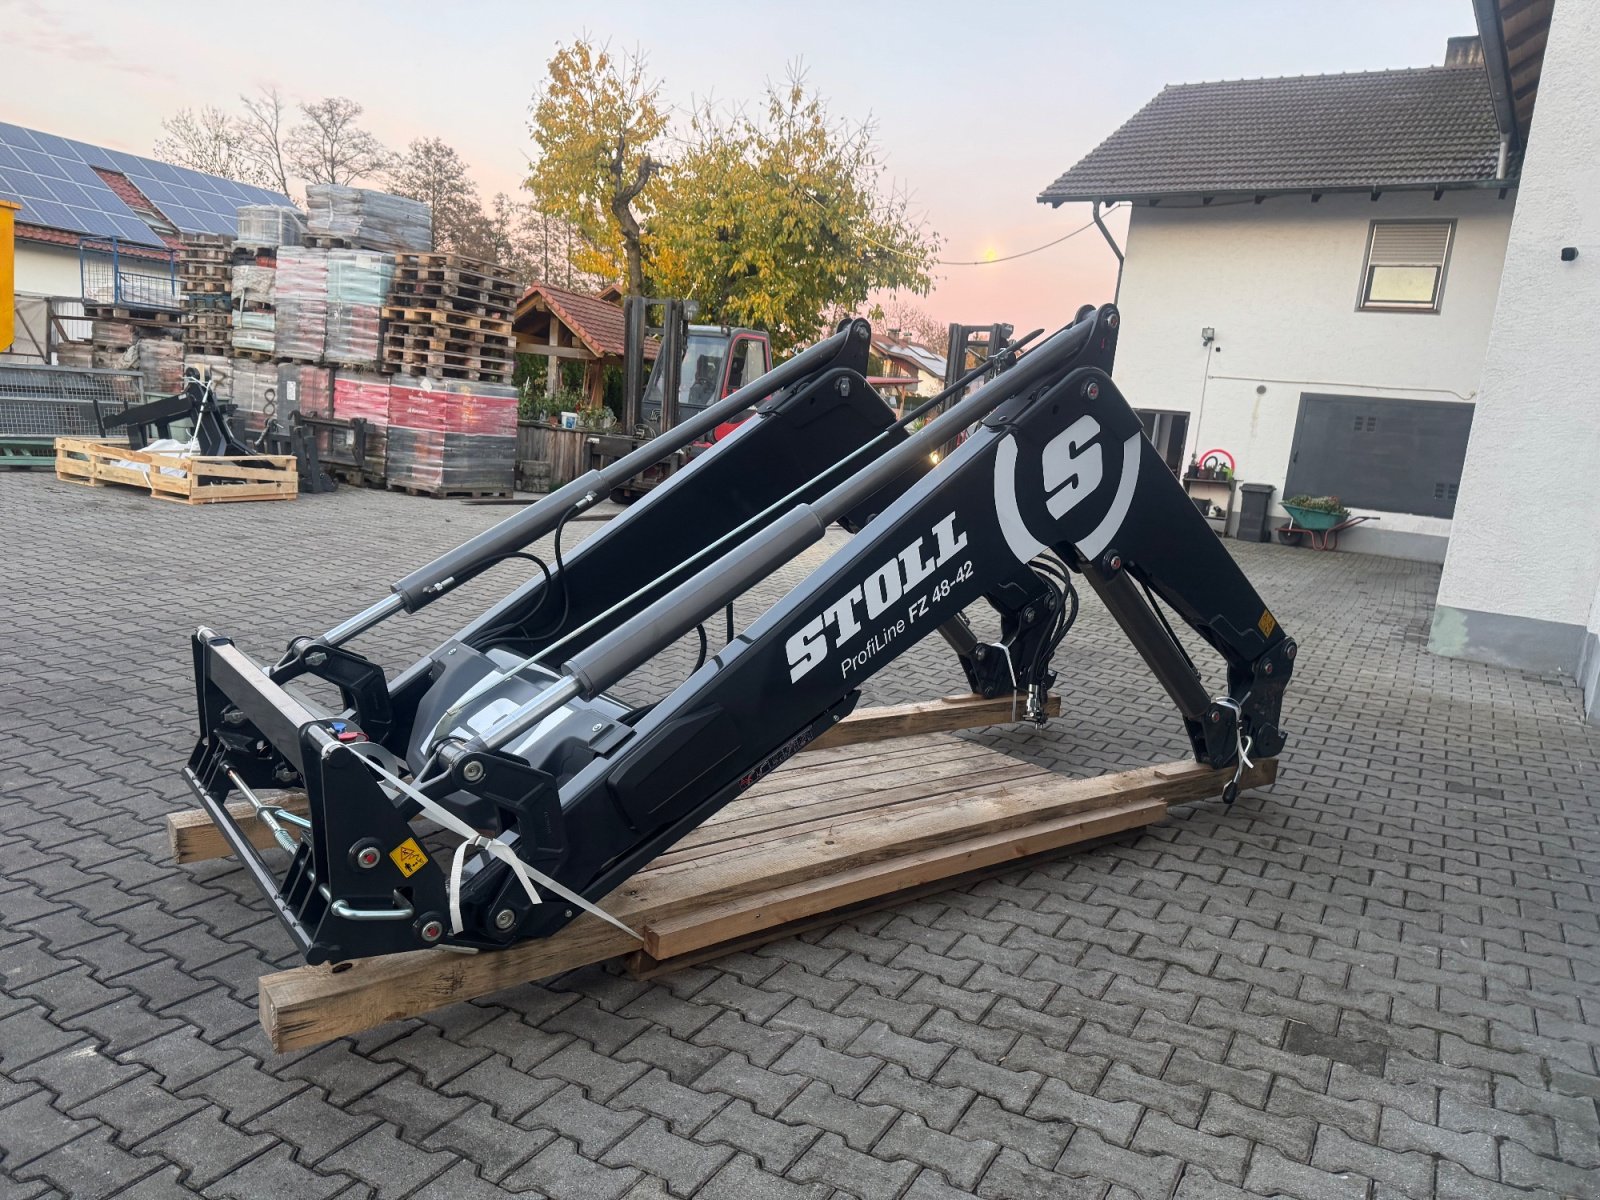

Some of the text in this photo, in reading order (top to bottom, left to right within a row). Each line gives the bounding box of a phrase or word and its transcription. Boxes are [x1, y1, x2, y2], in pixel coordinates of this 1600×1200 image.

[1042, 414, 1103, 520] S
[785, 511, 967, 684] STOLL
[841, 560, 974, 679] ProfiLine FZ 48-42
